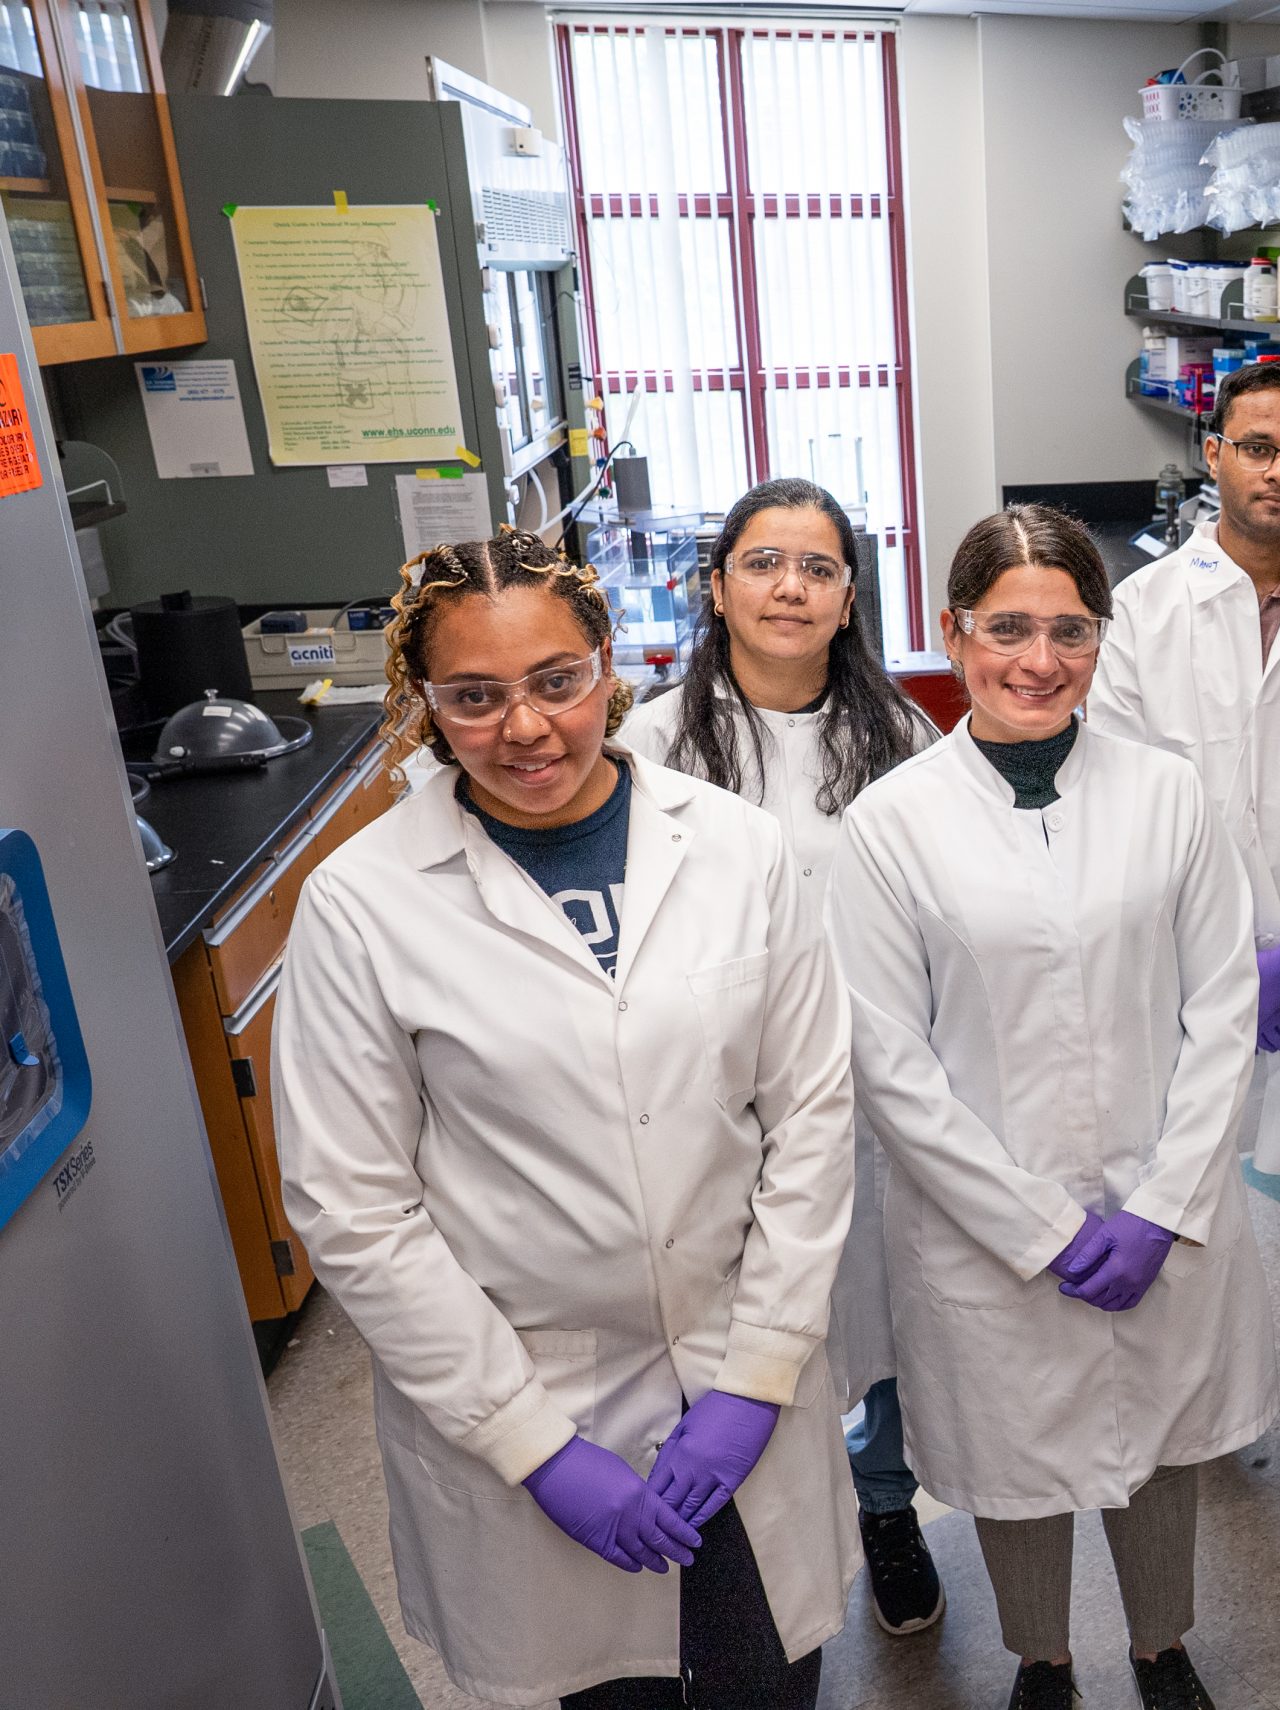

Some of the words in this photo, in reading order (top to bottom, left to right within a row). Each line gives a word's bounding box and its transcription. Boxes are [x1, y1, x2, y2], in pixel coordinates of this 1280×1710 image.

[361, 425, 456, 439] www.ehs.uconn.edu
[291, 645, 333, 660] acniti
[70, 1141, 94, 1177] Series
